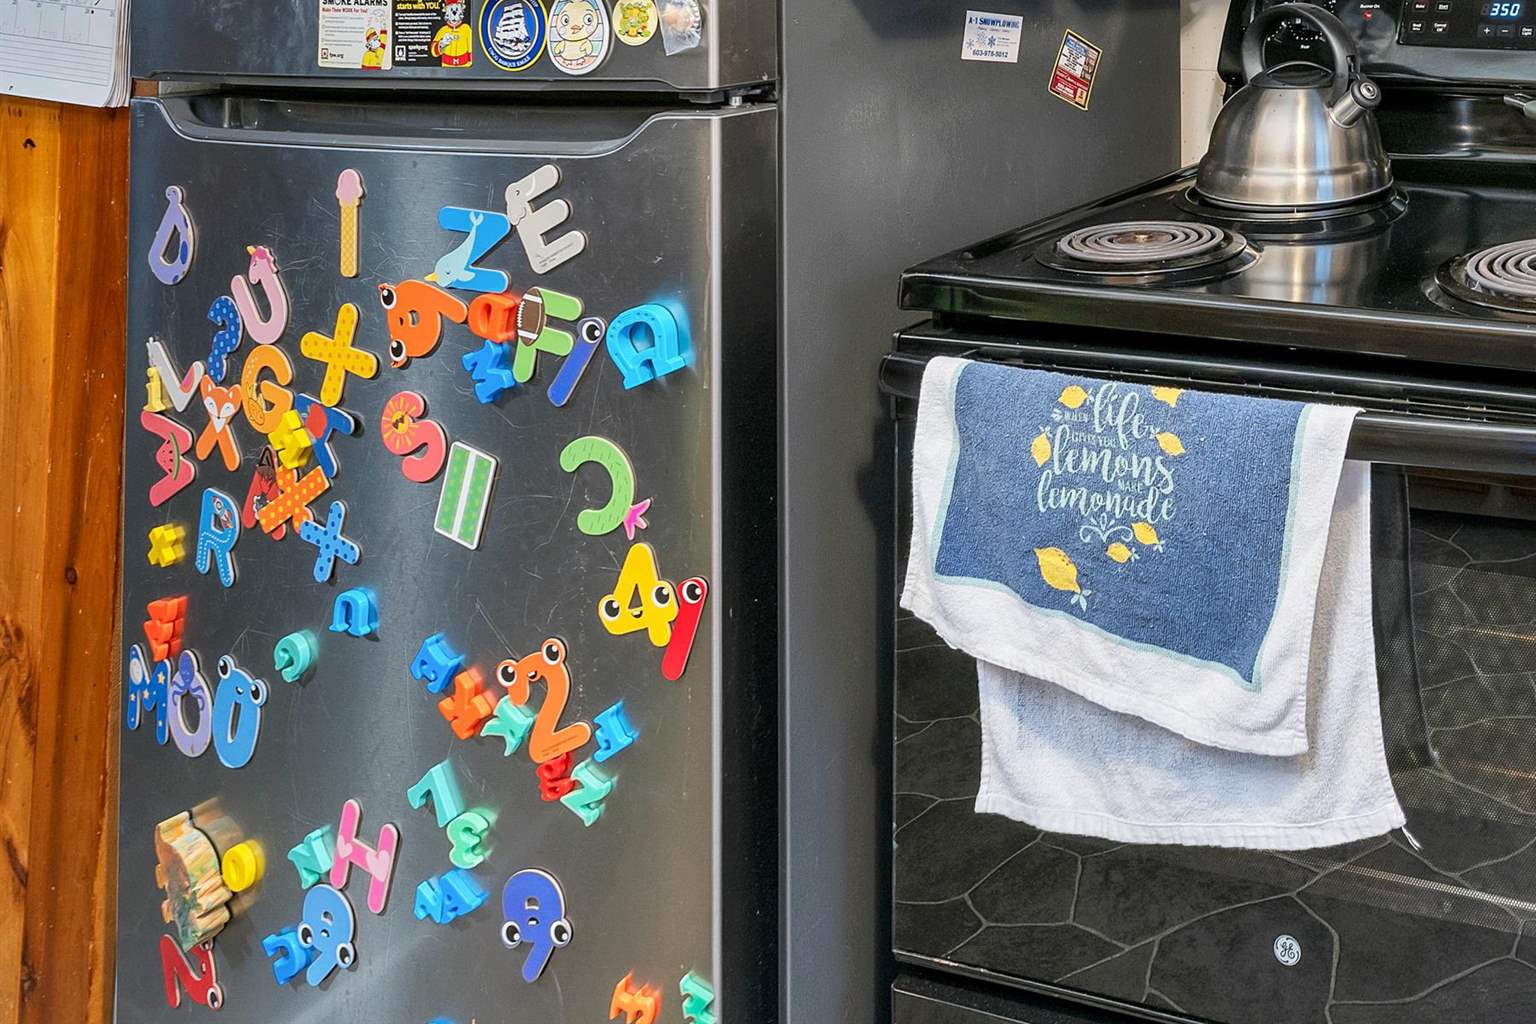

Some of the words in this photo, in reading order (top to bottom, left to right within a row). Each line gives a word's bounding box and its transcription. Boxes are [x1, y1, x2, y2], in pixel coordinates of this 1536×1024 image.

[412, 2, 426, 10] with
[1490, 3, 1521, 17] 350
[1093, 382, 1149, 450] life
[1052, 424, 1176, 494] lemons
[1117, 479, 1143, 493] MAKE
[1036, 470, 1178, 524] lemonade
[195, 487, 241, 588] R
[598, 541, 680, 647] 4
[496, 637, 593, 764] 2
[330, 799, 400, 914] H
